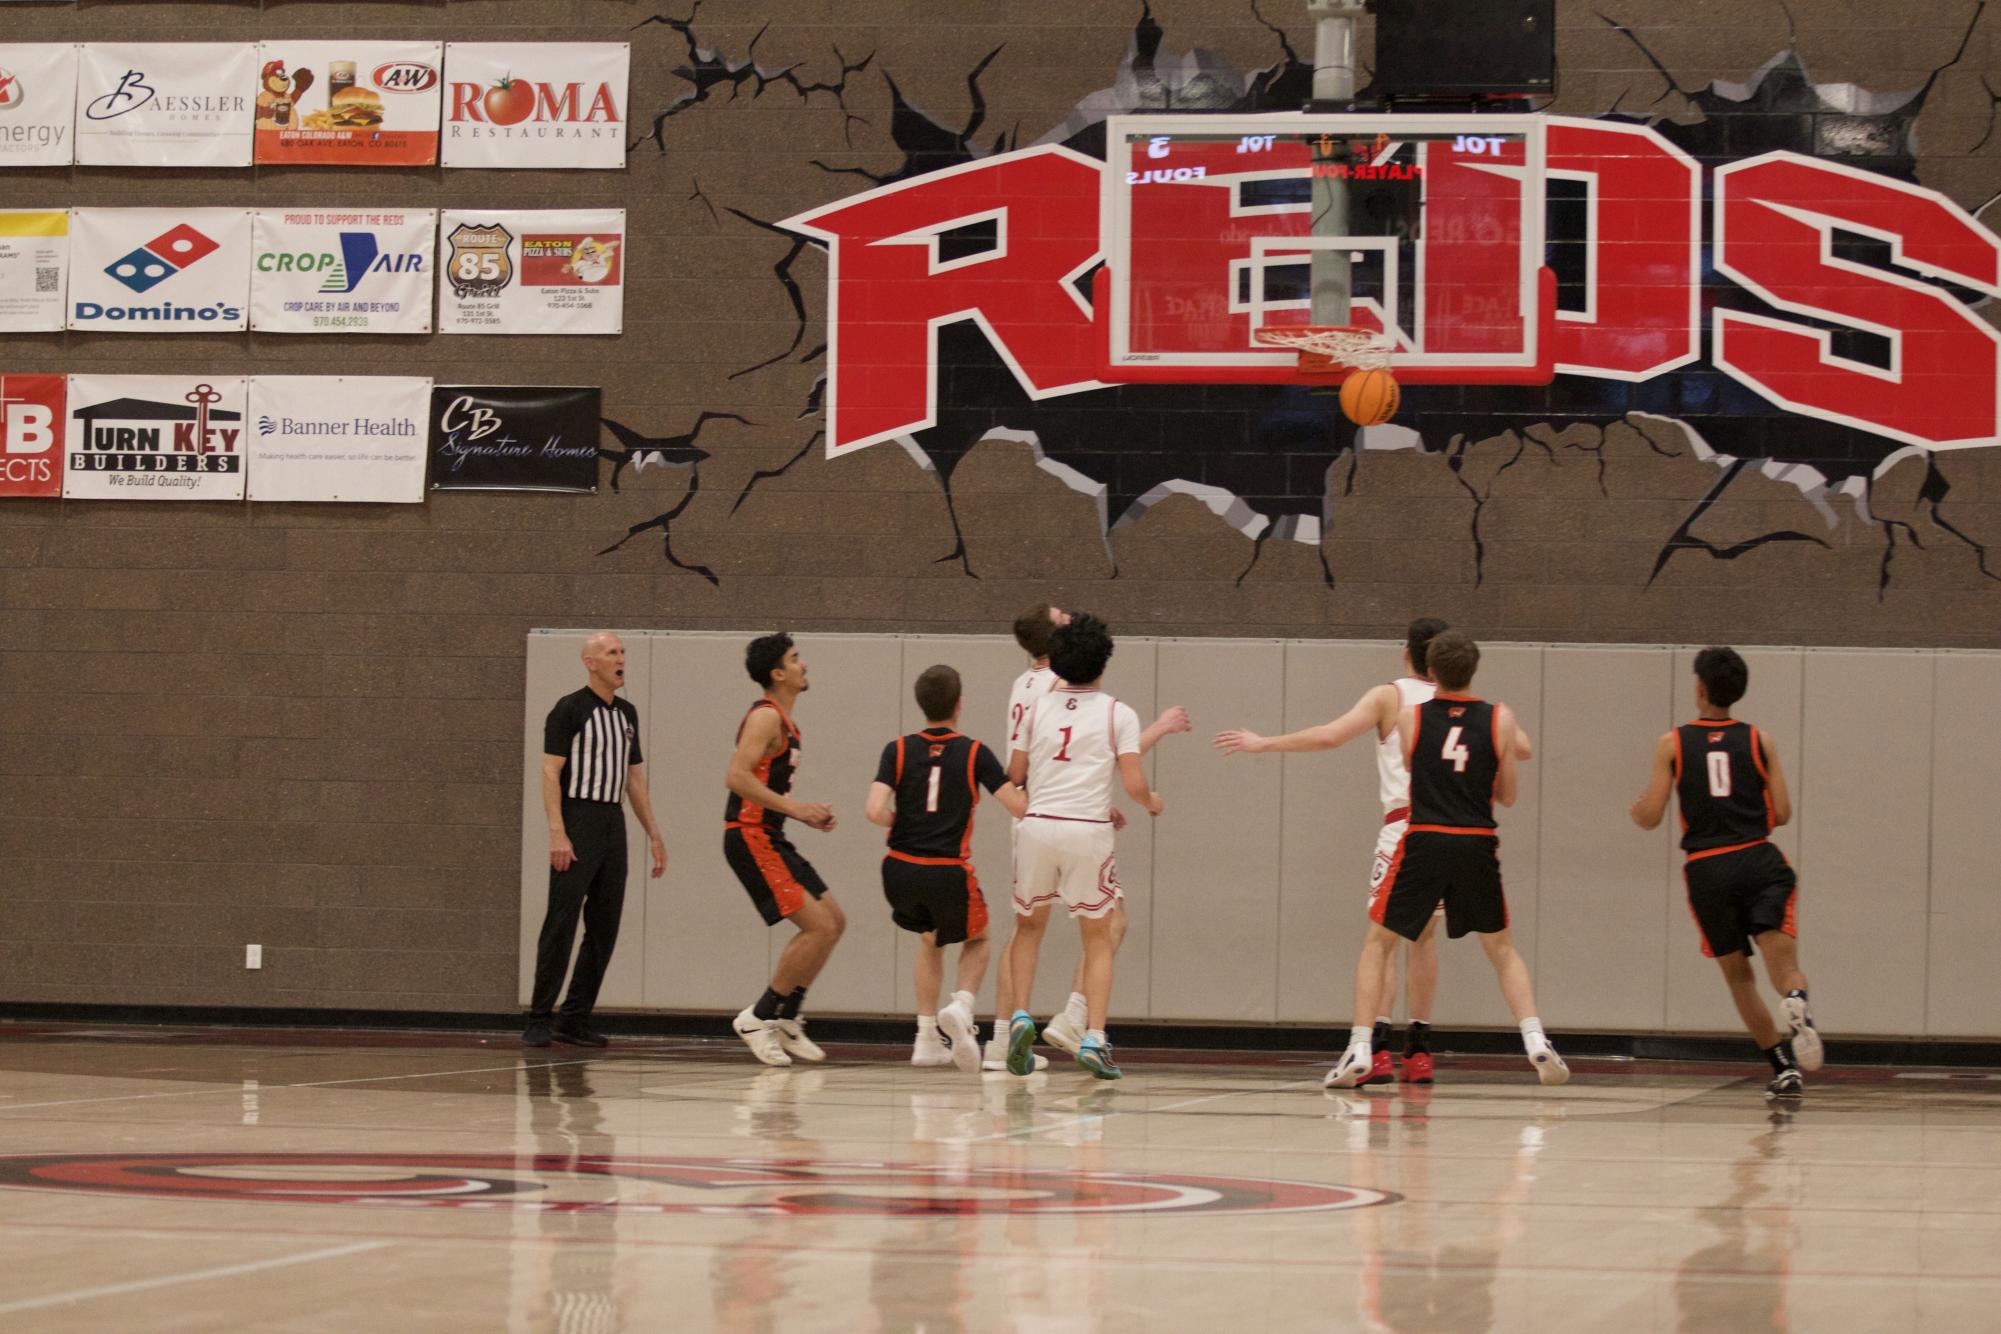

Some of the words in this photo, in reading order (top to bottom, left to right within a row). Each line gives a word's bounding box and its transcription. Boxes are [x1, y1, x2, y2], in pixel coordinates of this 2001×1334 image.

[451, 126, 618, 138] RESTAURANT
[284, 214, 312, 225] PROUD
[314, 214, 325, 225] TO
[326, 214, 363, 225] SUPPORT
[366, 214, 381, 225] THE
[383, 215, 404, 225] REDS
[463, 234, 498, 243] ROUTE
[524, 240, 573, 248] EATON
[257, 252, 335, 272] CROP
[372, 254, 424, 272] AIR
[458, 252, 500, 280] 85
[773, 113, 2001, 460] REDS
[75, 302, 241, 320] Domino's
[284, 302, 303, 311] CROP
[305, 302, 324, 311] CARE
[326, 302, 337, 311] BY
[353, 303, 369, 312] AND
[370, 303, 400, 312] BEYOND
[281, 418, 350, 435] Banner
[353, 418, 416, 436] Health
[440, 432, 533, 472] Signature
[538, 435, 599, 459] Homes
[74, 455, 229, 472] BUILDERS
[108, 474, 124, 486] We
[127, 475, 155, 487] Build
[157, 475, 202, 490] Quality!
[1052, 726, 1072, 761] 1
[1441, 726, 1470, 772] 4
[1706, 751, 1731, 797] 0
[926, 766, 942, 812] 1
